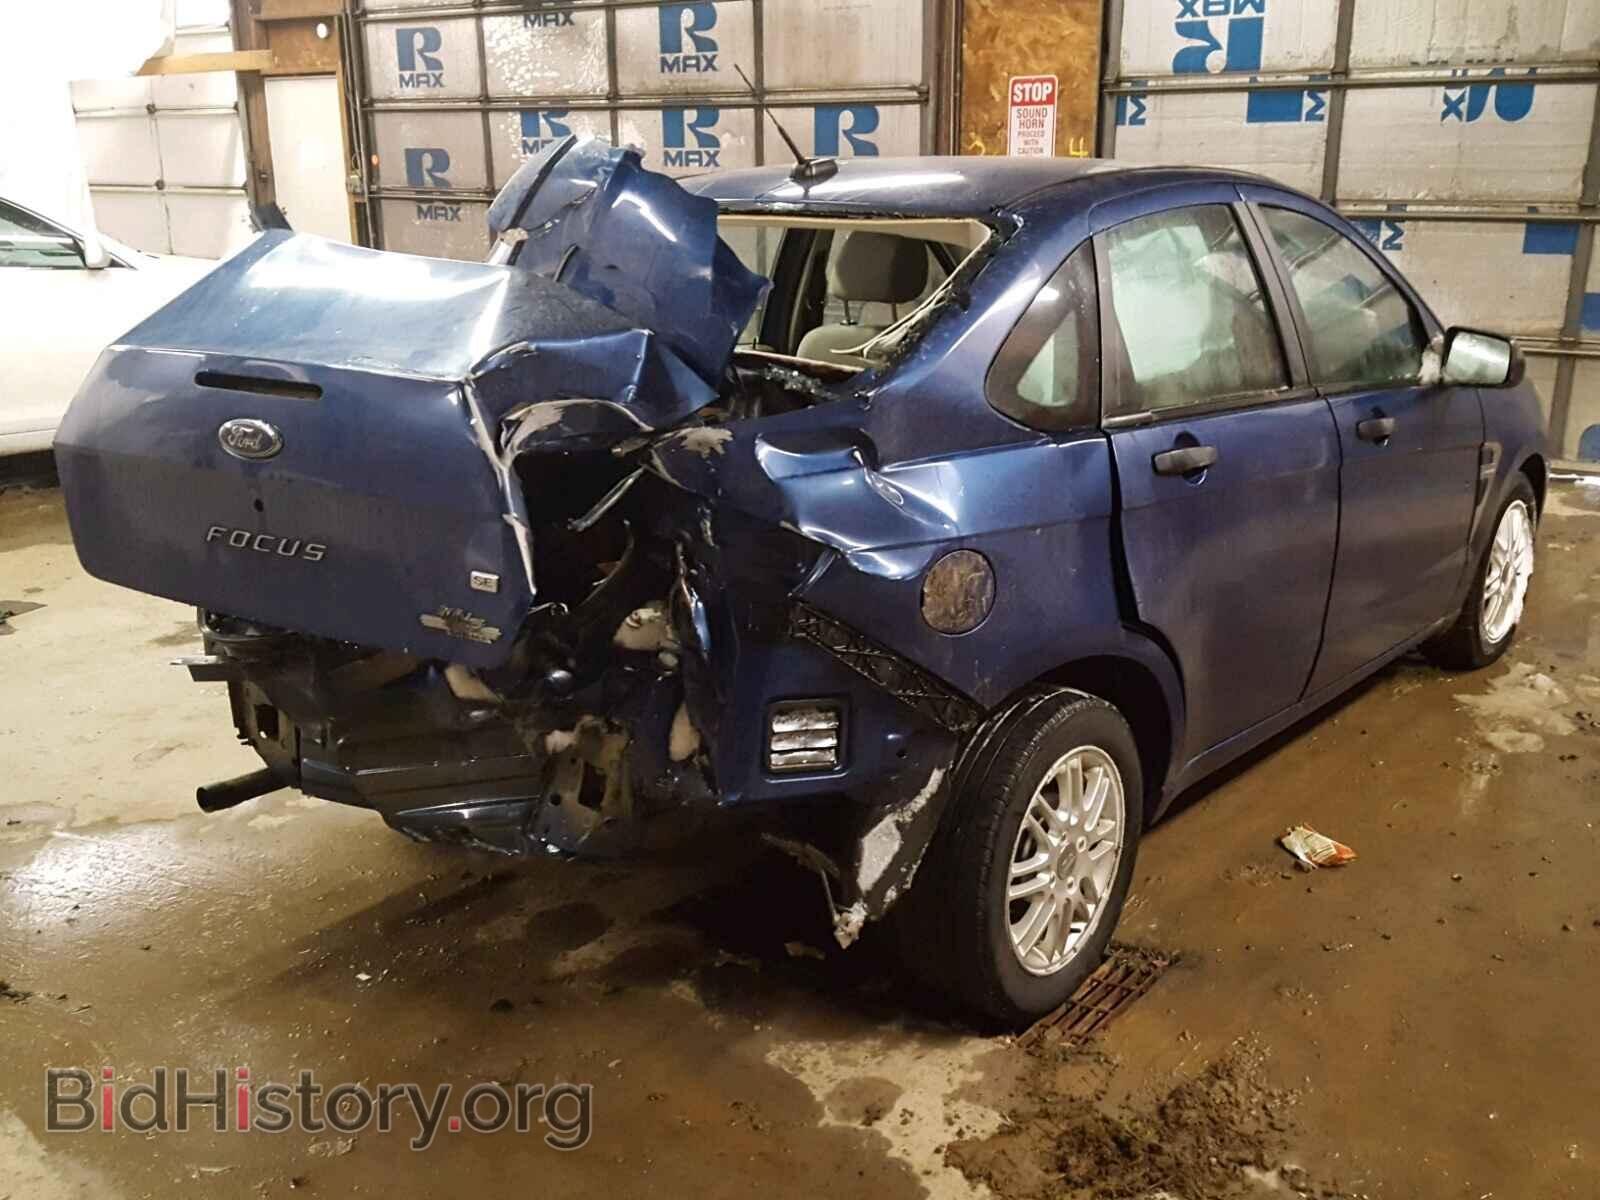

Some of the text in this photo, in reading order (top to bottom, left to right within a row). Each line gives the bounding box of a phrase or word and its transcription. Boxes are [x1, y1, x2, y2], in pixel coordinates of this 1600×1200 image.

[523, 11, 575, 28] MAX
[659, 2, 719, 53] R
[396, 27, 444, 71] R
[660, 54, 718, 73] MAX
[399, 72, 444, 88] MAX
[1013, 82, 1053, 103] STOP
[1017, 107, 1048, 119] SOUND
[662, 108, 721, 148] R
[813, 105, 880, 156] R
[1019, 119, 1044, 129] HORN
[404, 148, 451, 187] R
[663, 150, 720, 167] MAX
[416, 205, 462, 222] MAX
[227, 425, 263, 450] Ford
[206, 526, 327, 561] FOCUS
[473, 576, 497, 589] SE
